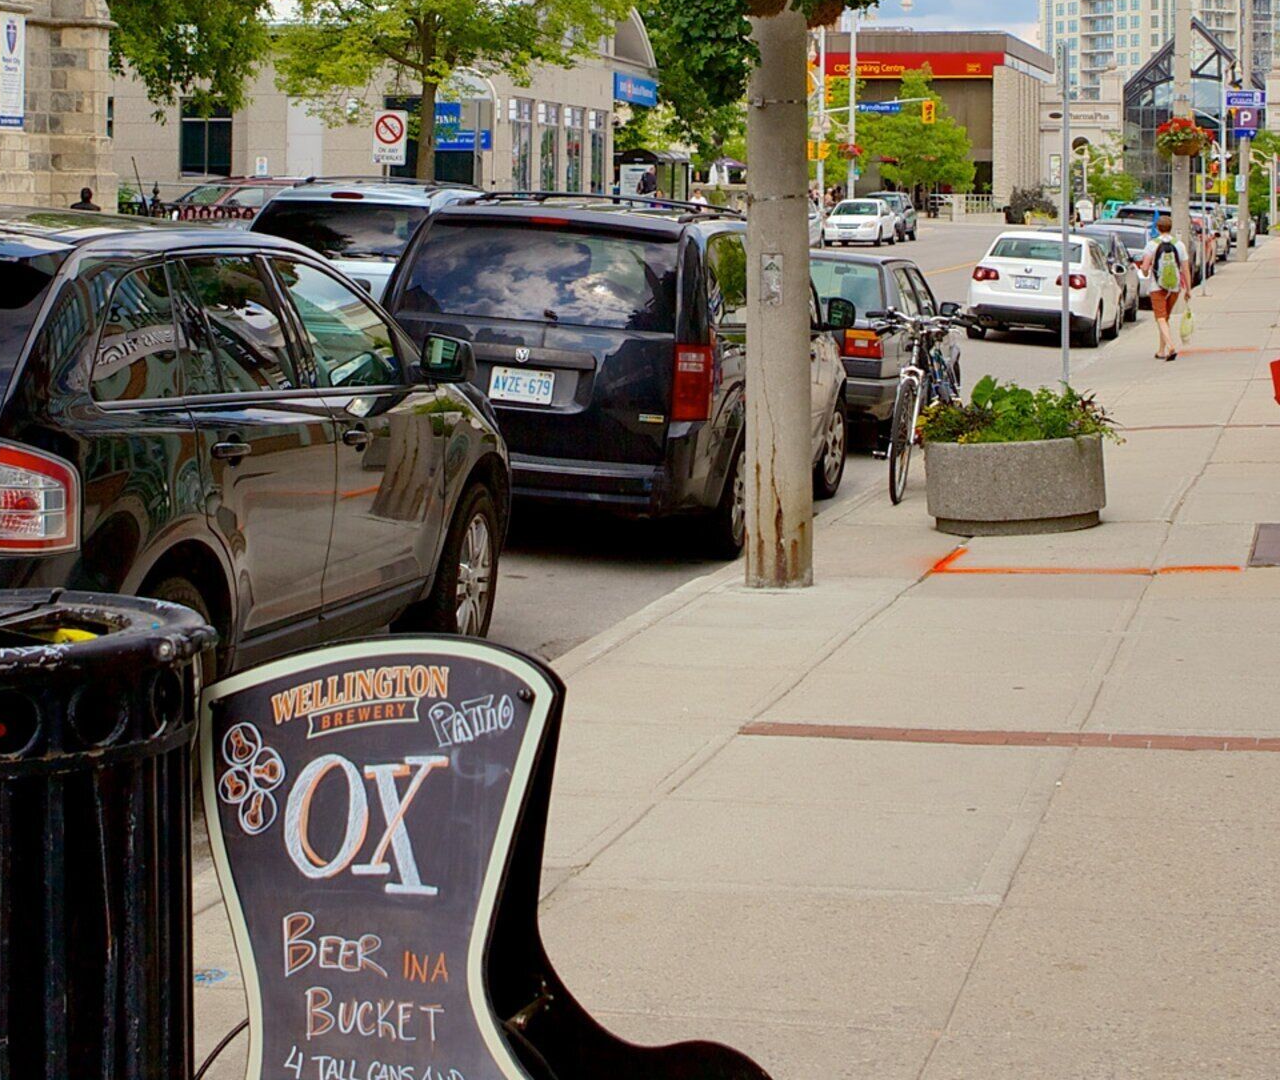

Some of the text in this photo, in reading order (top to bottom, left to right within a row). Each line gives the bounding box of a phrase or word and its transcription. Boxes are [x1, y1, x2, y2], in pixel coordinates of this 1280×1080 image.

[881, 64, 905, 72] Centre
[1240, 110, 1252, 126] P
[528, 379, 551, 396] 679
[270, 665, 450, 725] WELLINGTON
[320, 703, 407, 731] BREWERY
[428, 694, 515, 748] PATIO
[284, 752, 450, 897] OX
[283, 911, 388, 978] BEER
[305, 986, 445, 1041] BUCKET
[284, 1045, 303, 1079] 4
[311, 1056, 356, 1080] TALL
[368, 1061, 414, 1080] CANS
